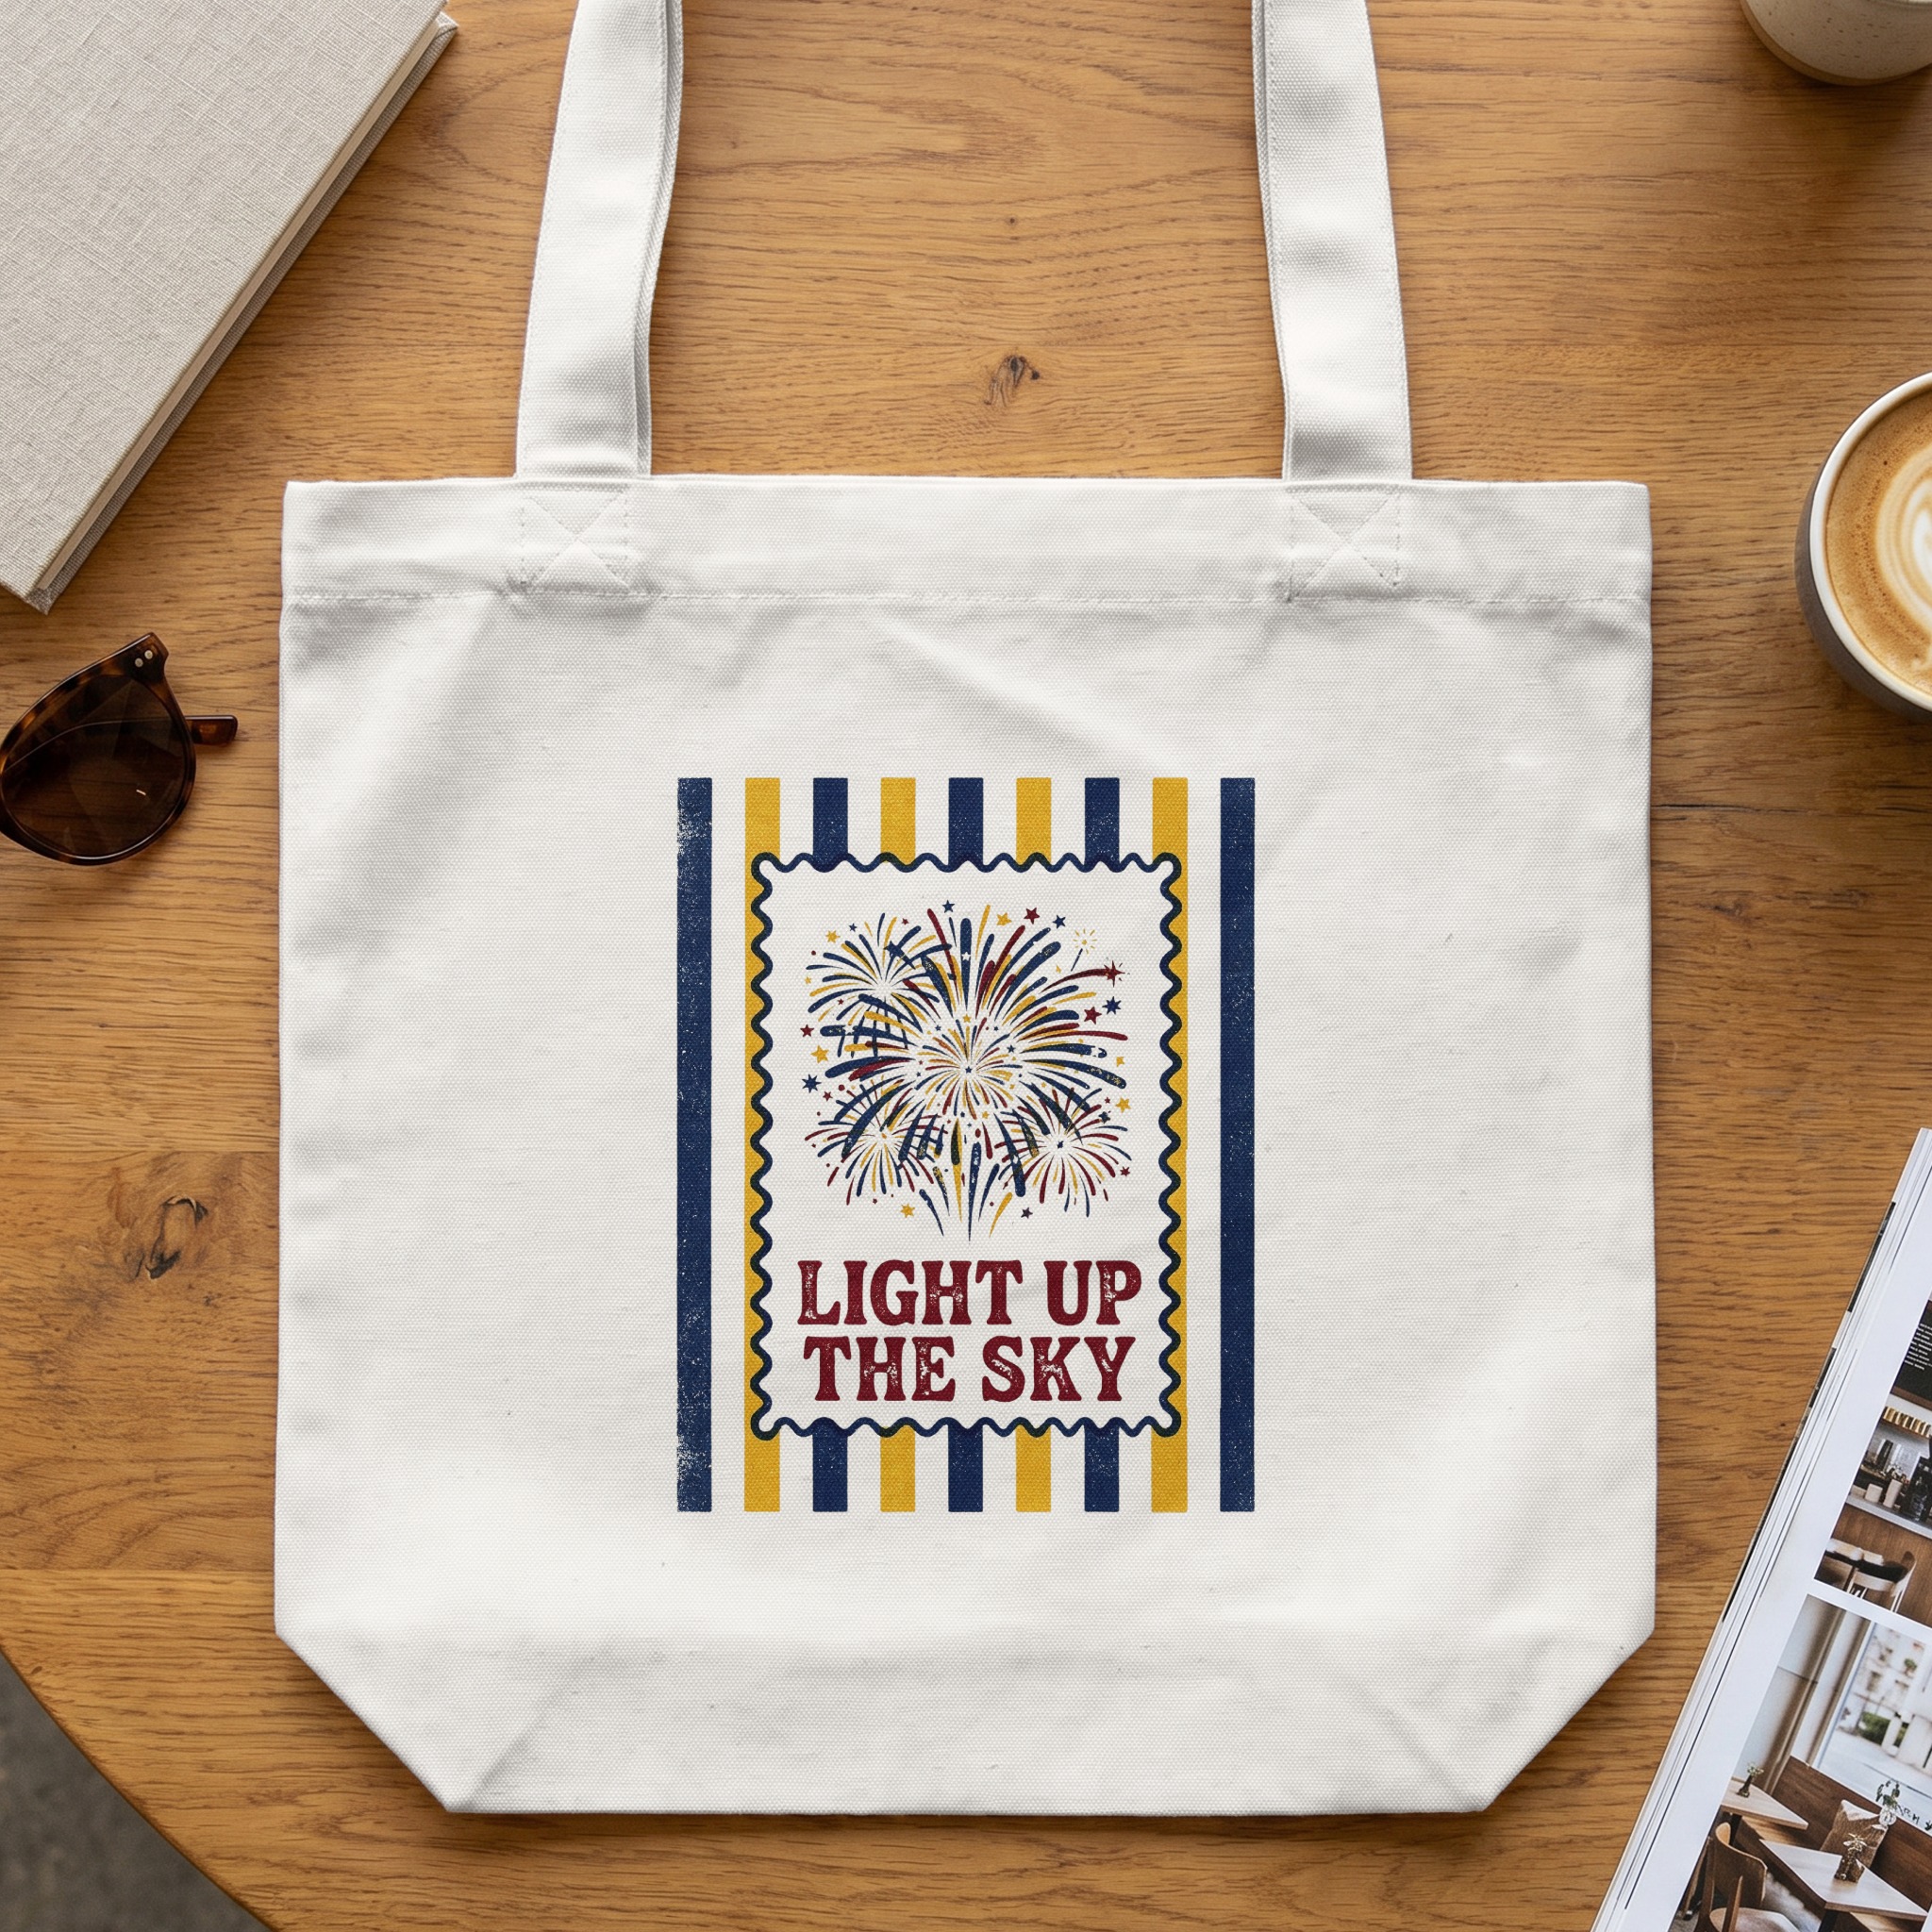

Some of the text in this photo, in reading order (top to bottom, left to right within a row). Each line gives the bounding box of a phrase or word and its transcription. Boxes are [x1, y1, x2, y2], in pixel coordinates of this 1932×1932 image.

[797, 1259, 1141, 1325] LIGHT UP
[803, 1336, 1136, 1402] THE SKY
